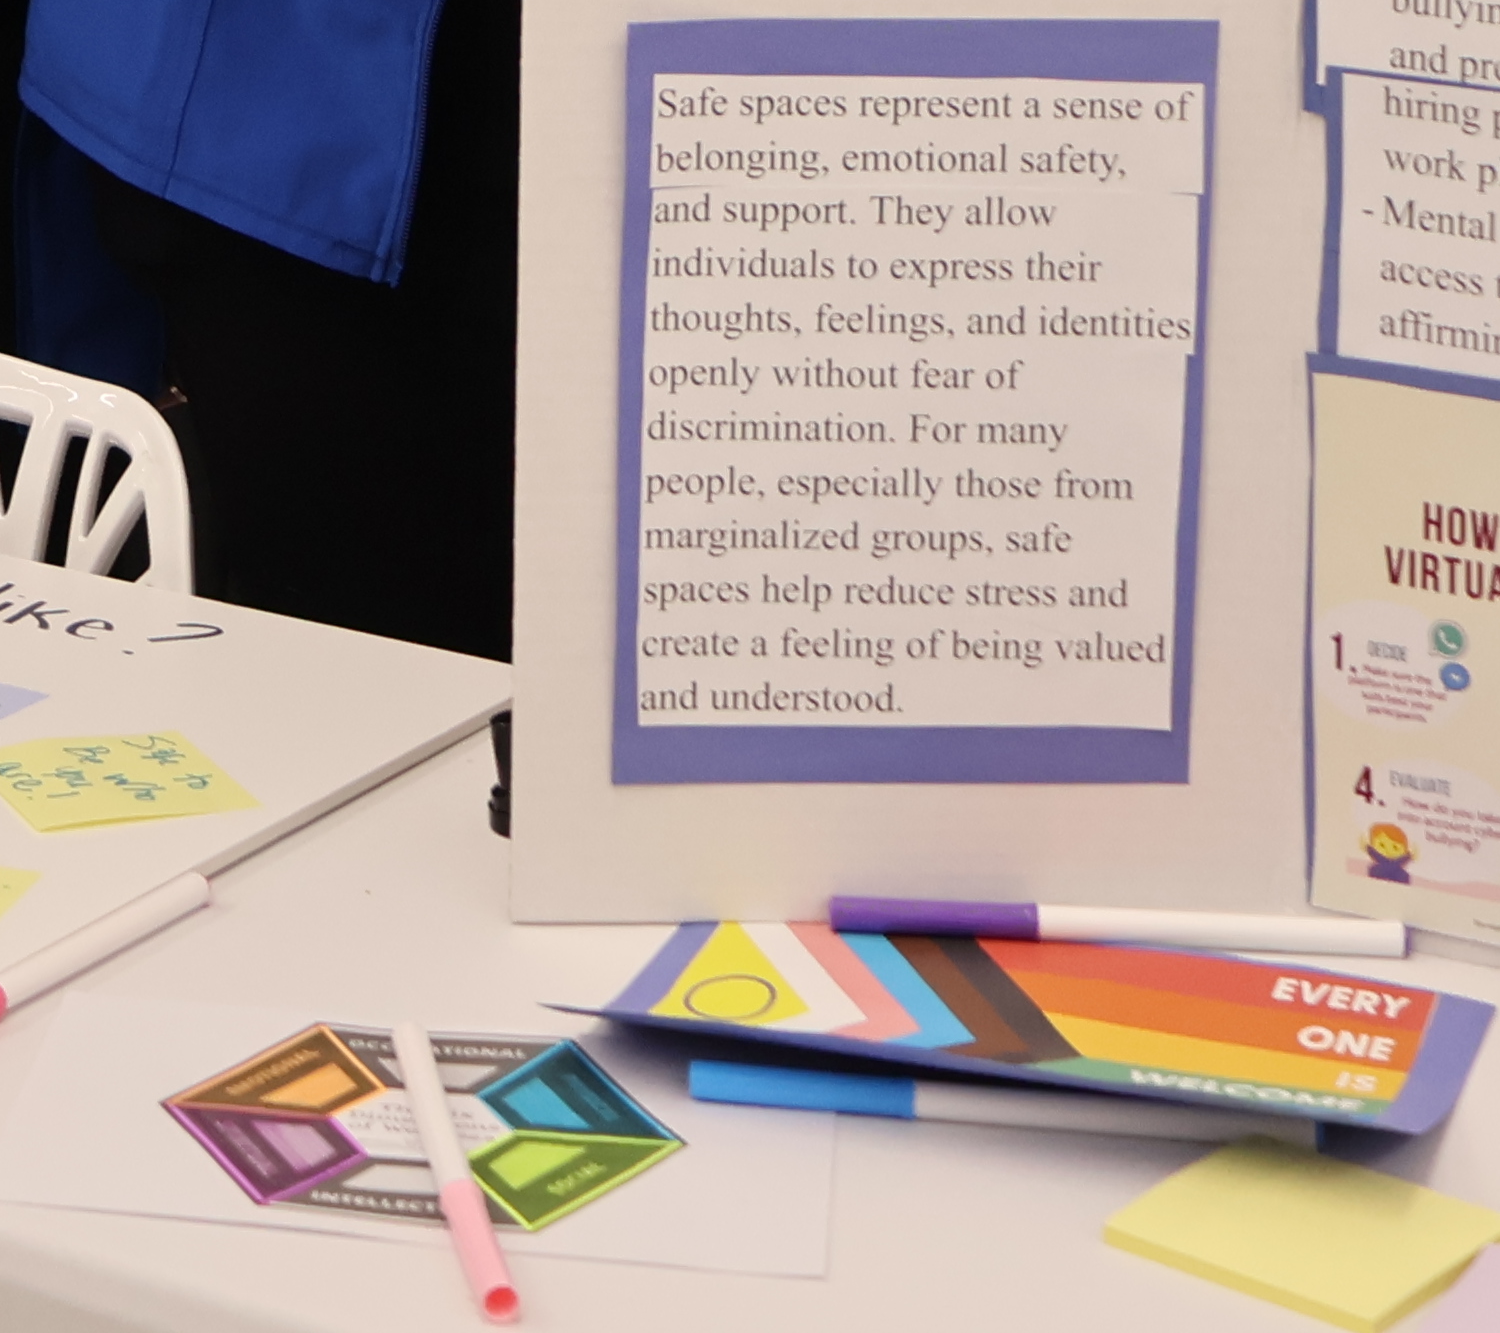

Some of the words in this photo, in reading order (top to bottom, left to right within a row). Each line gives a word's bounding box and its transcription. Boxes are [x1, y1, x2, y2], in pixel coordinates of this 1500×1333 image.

[657, 85, 728, 118] Safe
[738, 94, 847, 125] spaces
[858, 93, 1012, 126] represent
[1022, 97, 1041, 119] a
[1052, 97, 1143, 120] sense
[1153, 90, 1195, 121] of
[1421, 499, 1500, 553] HOW
[1352, 765, 1387, 808] 4.
[1269, 975, 1412, 1020] EVERY
[1296, 1024, 1399, 1063] ONE
[1334, 1070, 1380, 1094] IS
